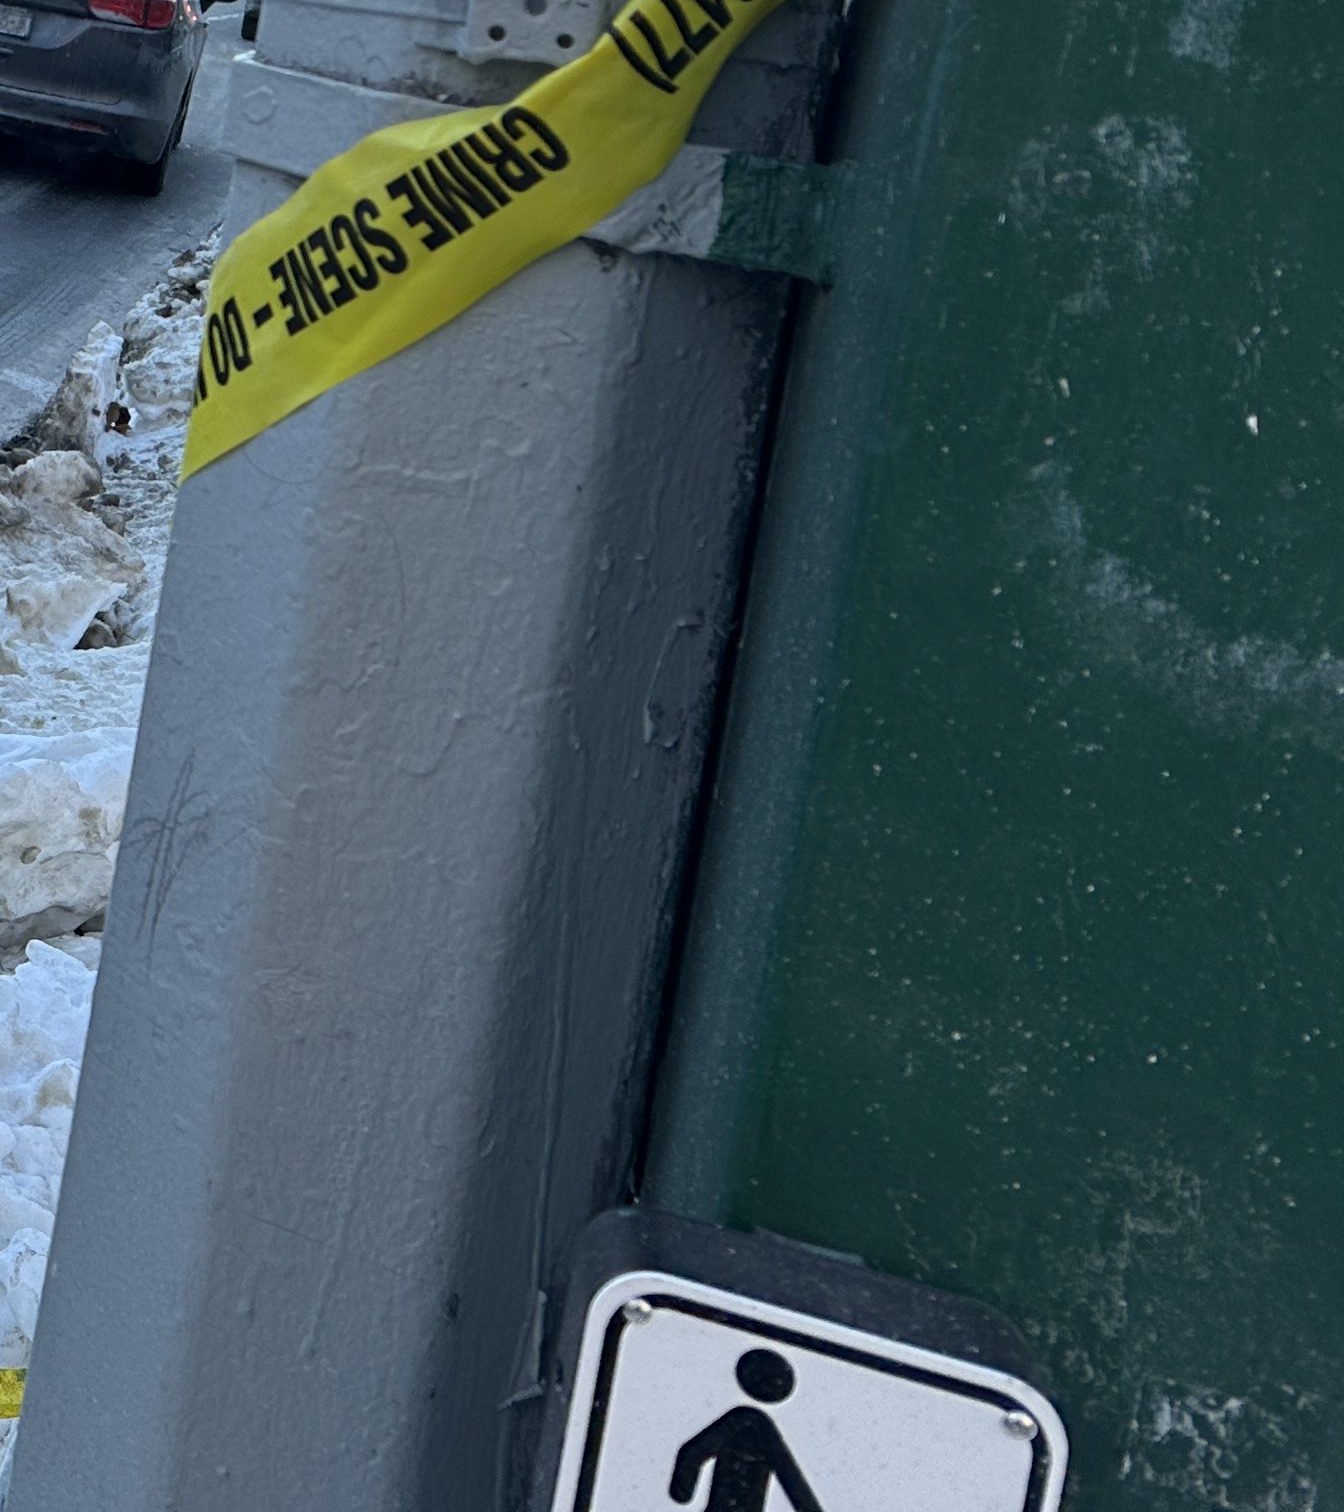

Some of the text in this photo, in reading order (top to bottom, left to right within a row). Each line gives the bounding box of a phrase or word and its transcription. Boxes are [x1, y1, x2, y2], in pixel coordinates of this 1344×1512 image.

[385, 105, 570, 253] CRIME
[269, 197, 408, 337] SCENE
[207, 296, 253, 387] DO
